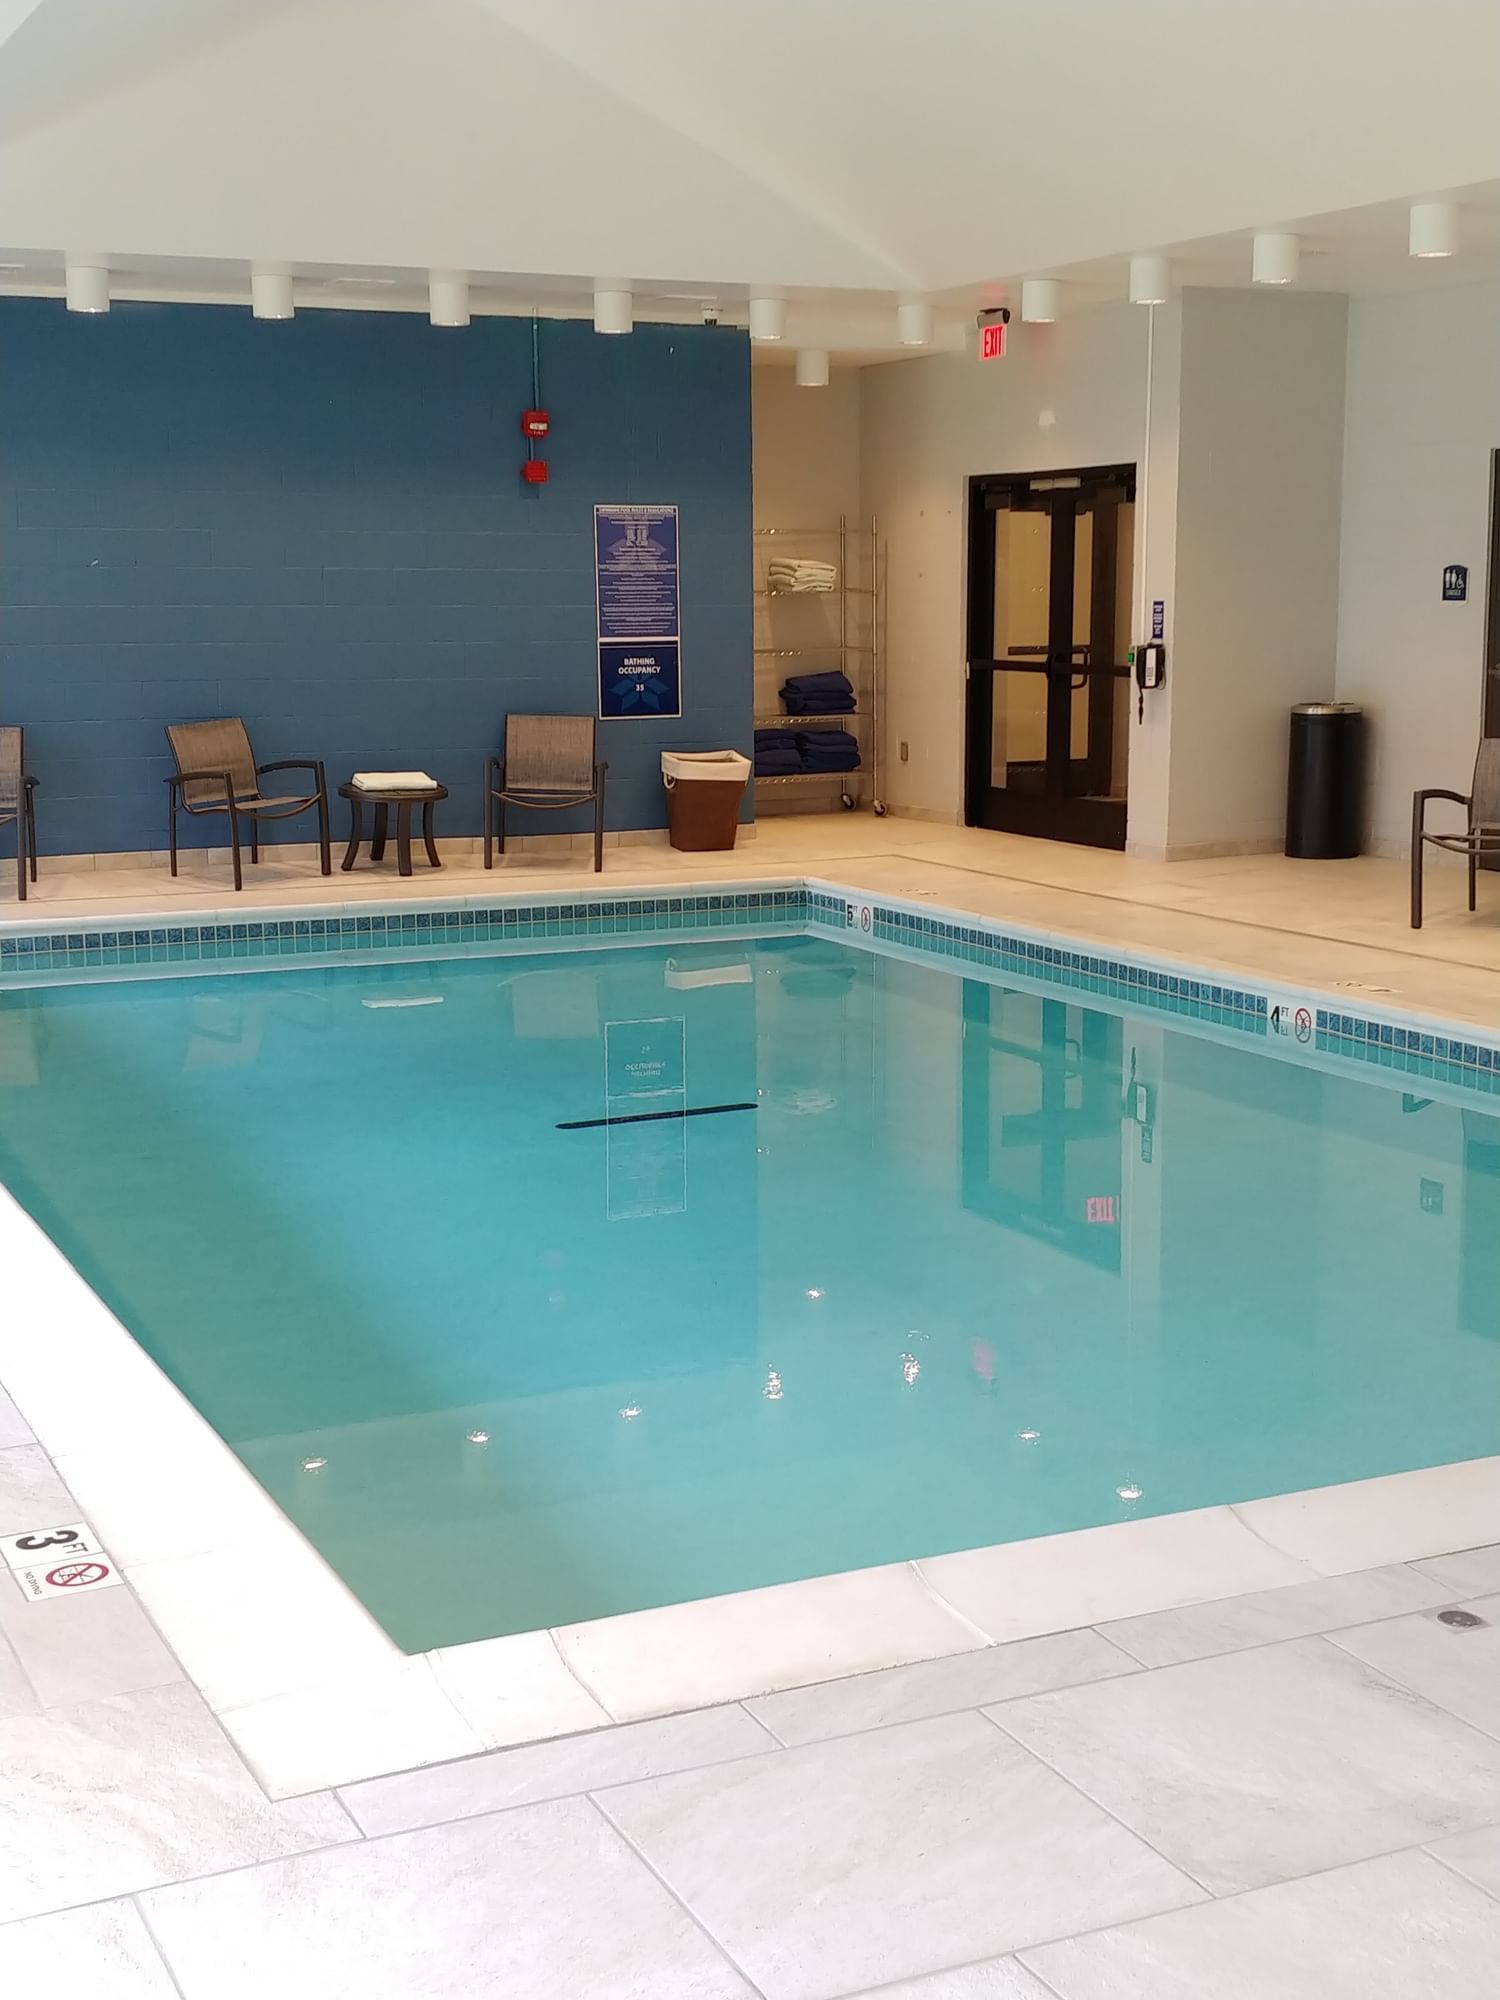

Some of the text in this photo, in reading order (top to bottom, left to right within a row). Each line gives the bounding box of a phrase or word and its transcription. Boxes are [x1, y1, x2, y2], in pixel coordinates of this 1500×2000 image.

[984, 326, 1003, 357] EXIT
[624, 657, 655, 666] BATHING
[618, 666, 661, 674] OCCUPANCY
[1281, 1007, 1289, 1016] FT
[15, 1530, 89, 1554] 3 FT
[24, 1571, 43, 1595] NO DIVING
